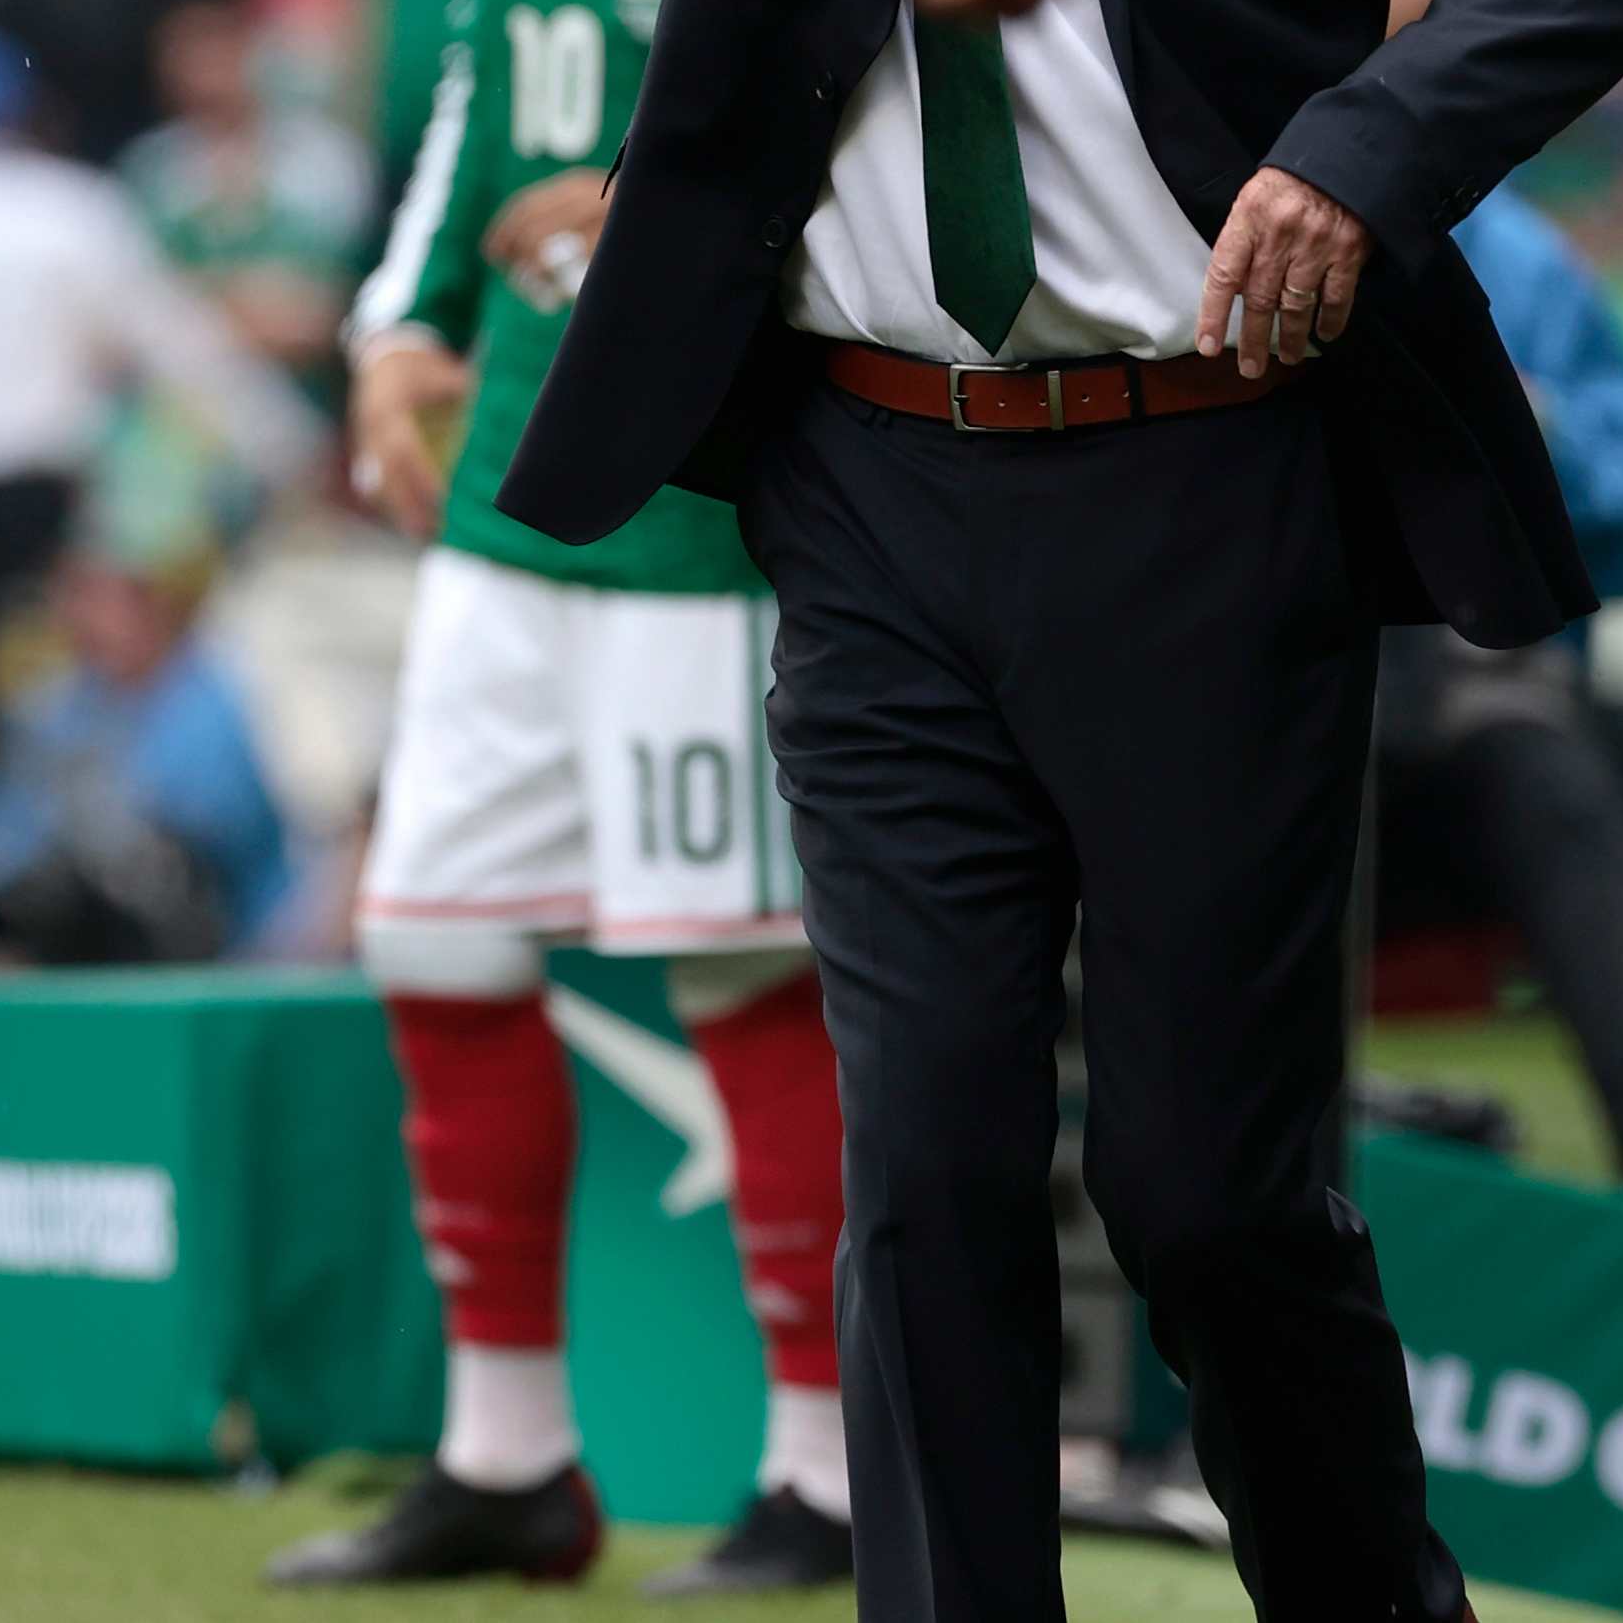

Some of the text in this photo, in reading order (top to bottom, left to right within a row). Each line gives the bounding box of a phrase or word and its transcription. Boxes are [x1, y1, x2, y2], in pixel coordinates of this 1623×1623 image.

[507, 5, 604, 159] 10
[631, 734, 732, 867] 10
[1402, 1348, 1589, 1485] LD
